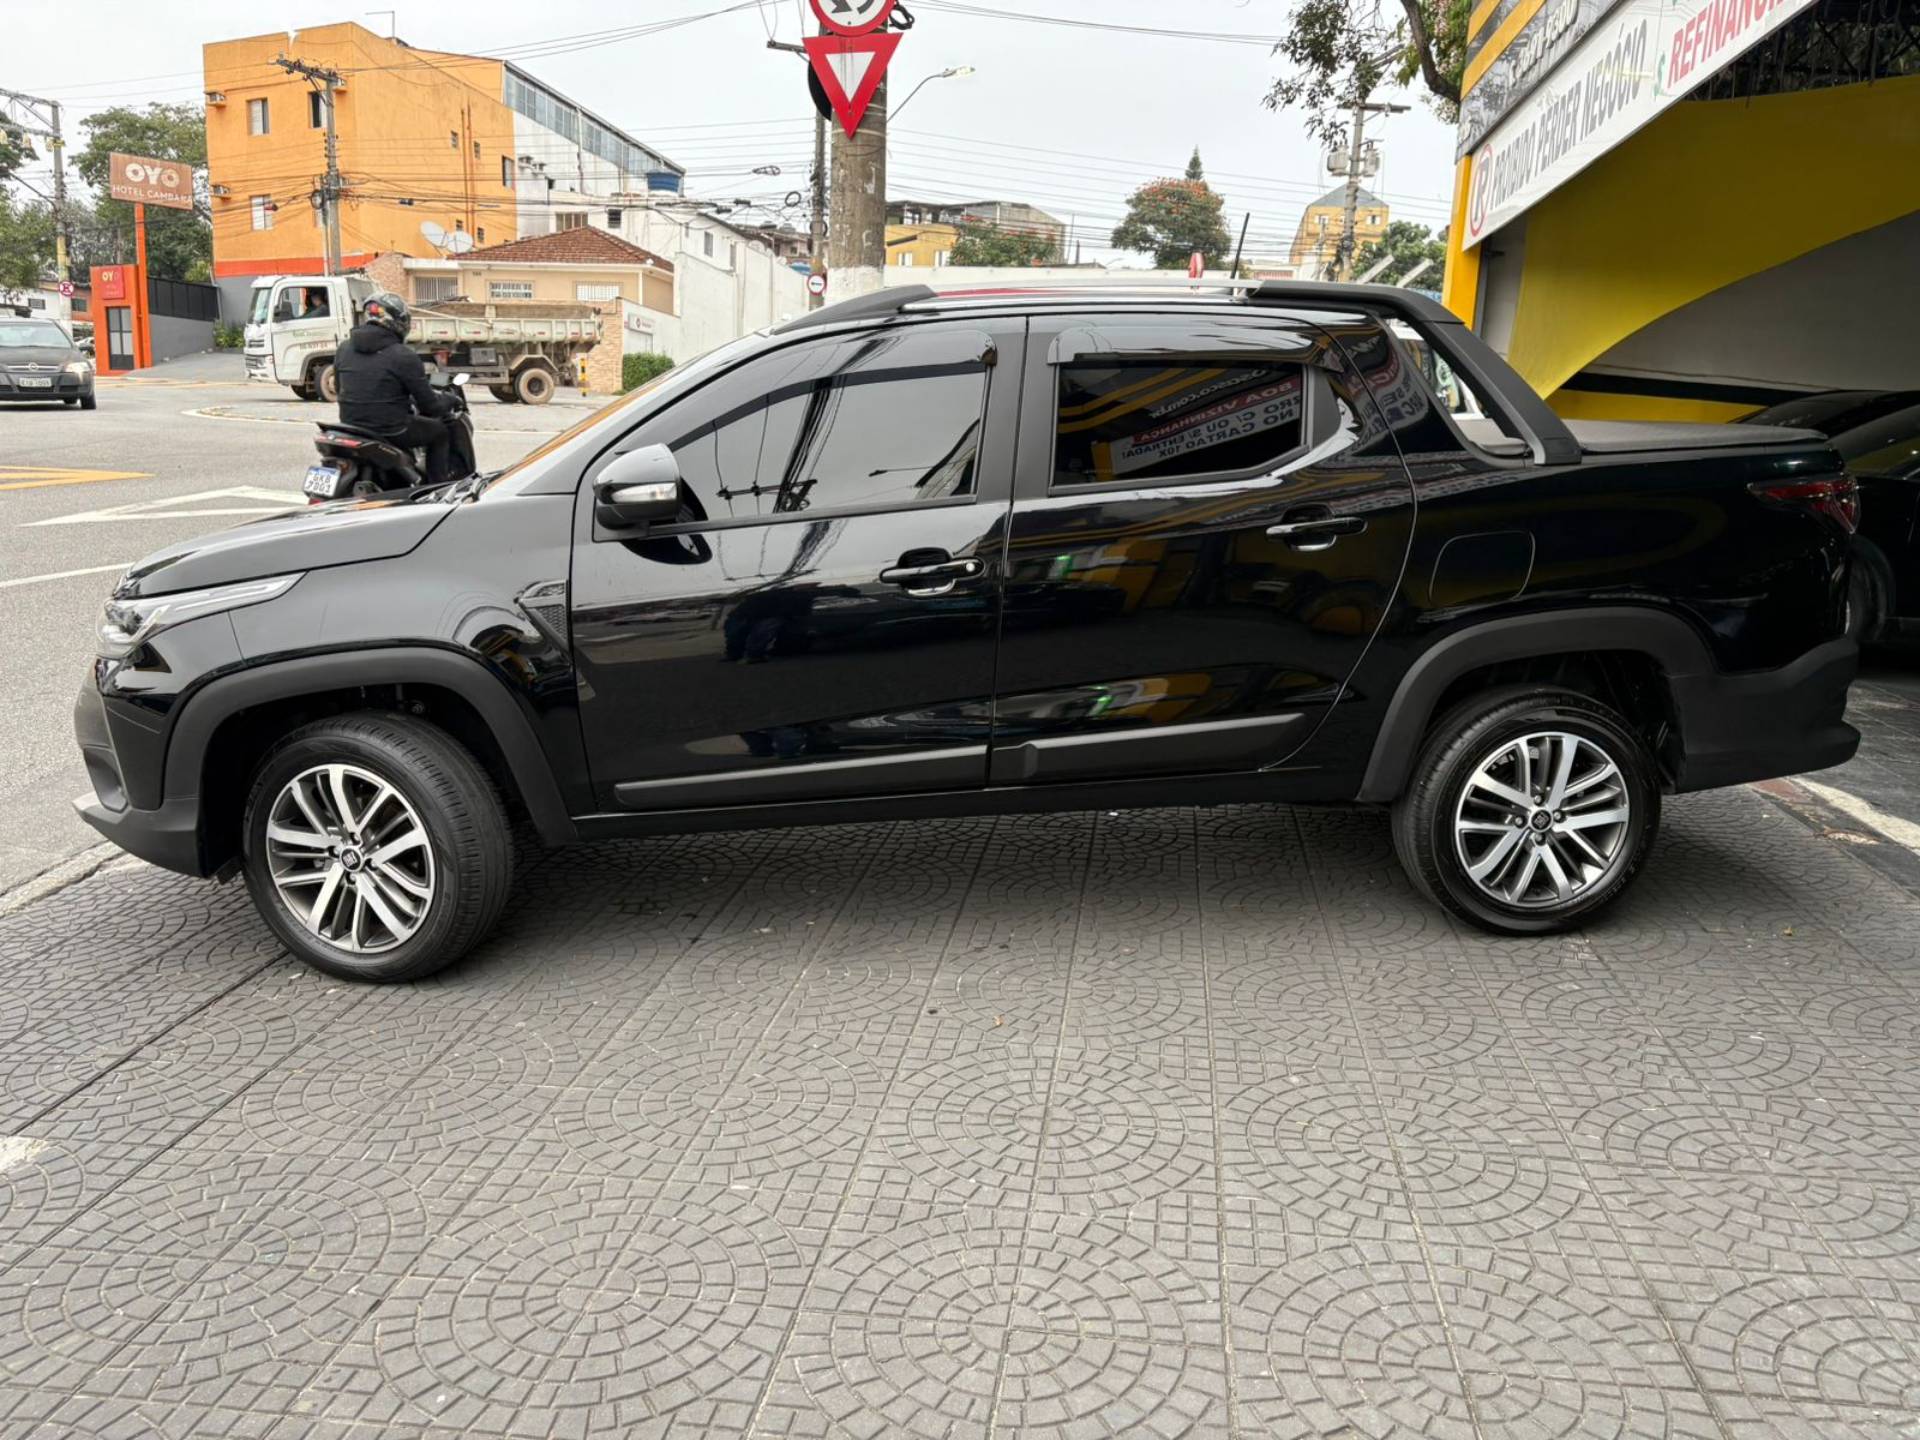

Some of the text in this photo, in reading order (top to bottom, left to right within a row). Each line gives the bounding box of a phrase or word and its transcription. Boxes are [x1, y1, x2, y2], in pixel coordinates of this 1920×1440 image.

[1667, 0, 1785, 89] REFINAN
[1535, 80, 1582, 177] PERDER
[1579, 19, 1647, 142] NEGÓCIO
[112, 183, 145, 197] HOTEL
[125, 163, 180, 188] OYO
